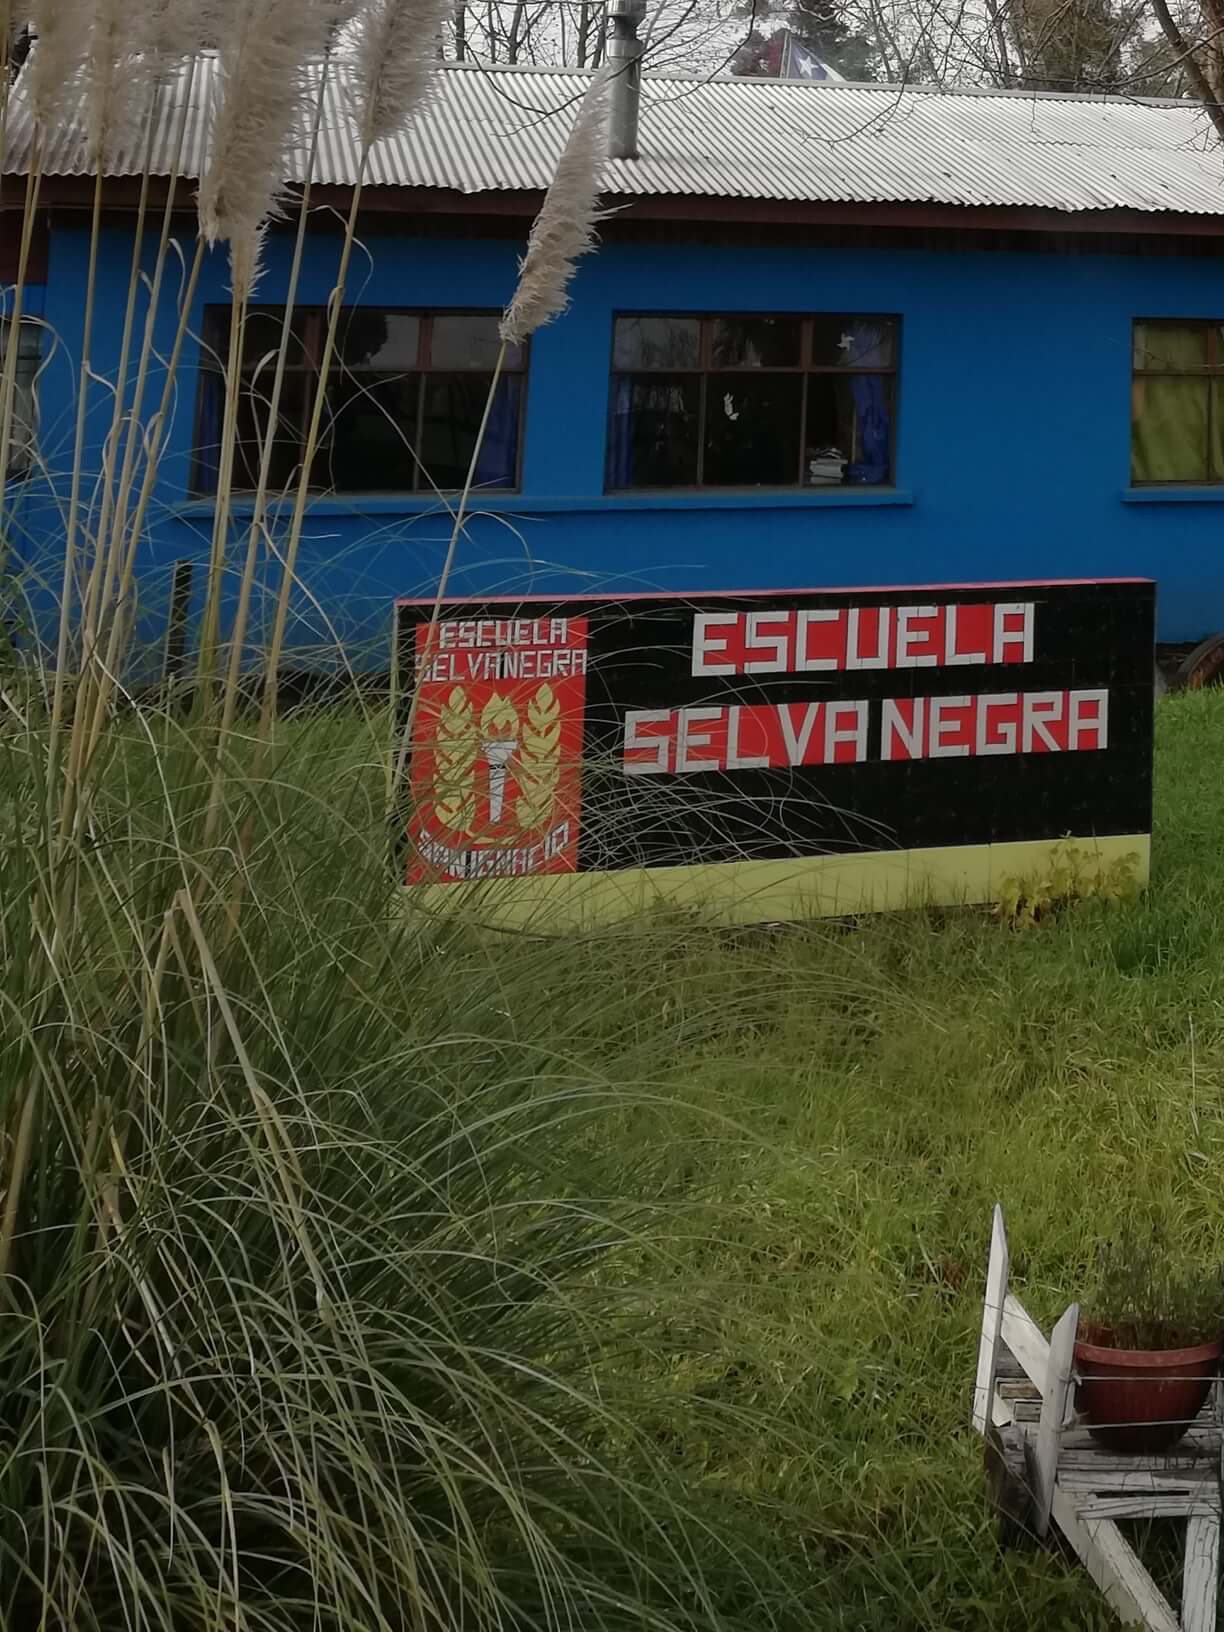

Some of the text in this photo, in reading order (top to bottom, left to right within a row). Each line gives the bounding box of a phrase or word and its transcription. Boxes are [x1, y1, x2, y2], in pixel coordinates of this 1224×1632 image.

[438, 618, 567, 649] ESCUELA
[692, 602, 1035, 677] ESCUELA
[415, 649, 588, 682] SELVA NEGRA
[624, 689, 1109, 775] SELVA NEGRA
